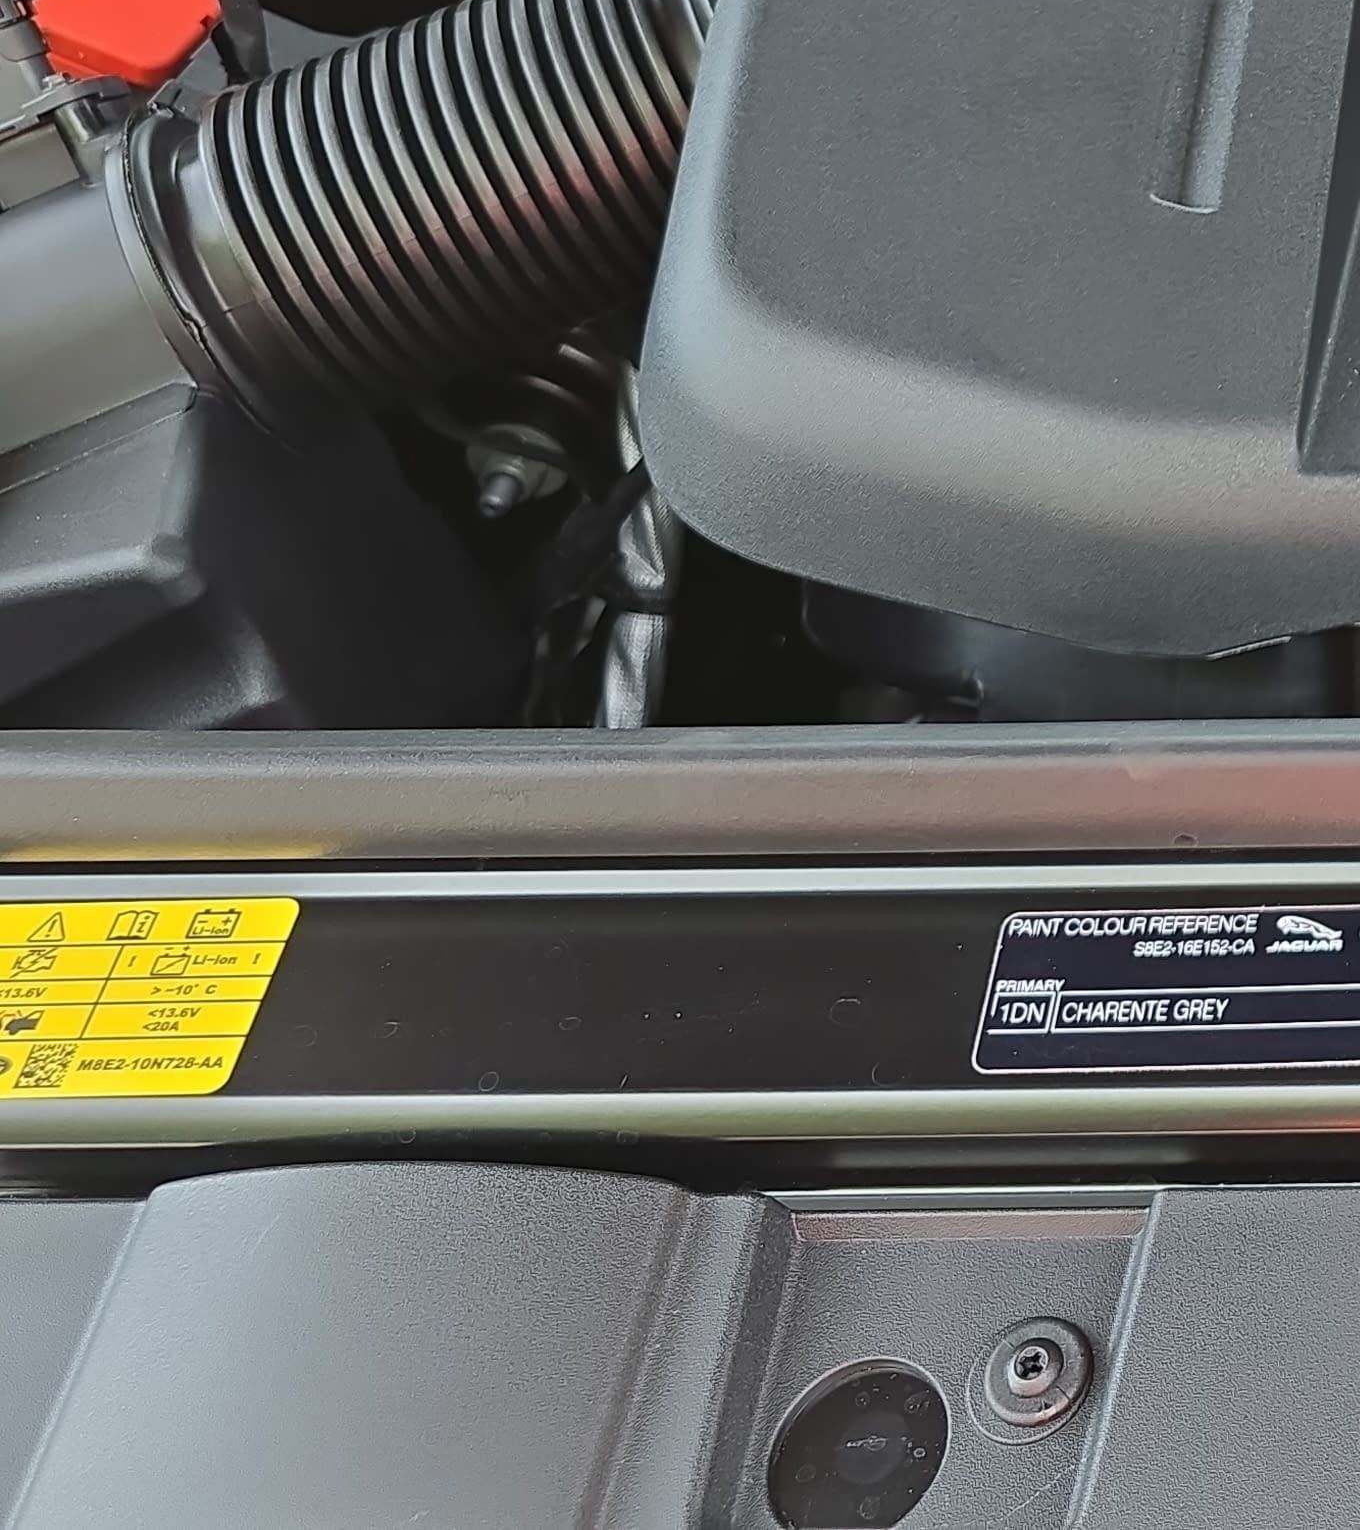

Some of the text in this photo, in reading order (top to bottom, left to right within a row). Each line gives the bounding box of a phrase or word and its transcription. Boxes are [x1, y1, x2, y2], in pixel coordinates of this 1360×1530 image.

[1008, 913, 1259, 937] PAINT COLOUR REFERENCE
[1265, 939, 1344, 953] JAGUAR
[996, 979, 1065, 992] PRIMARY
[1000, 998, 1229, 1023] 1DN CHARENTE GREY
